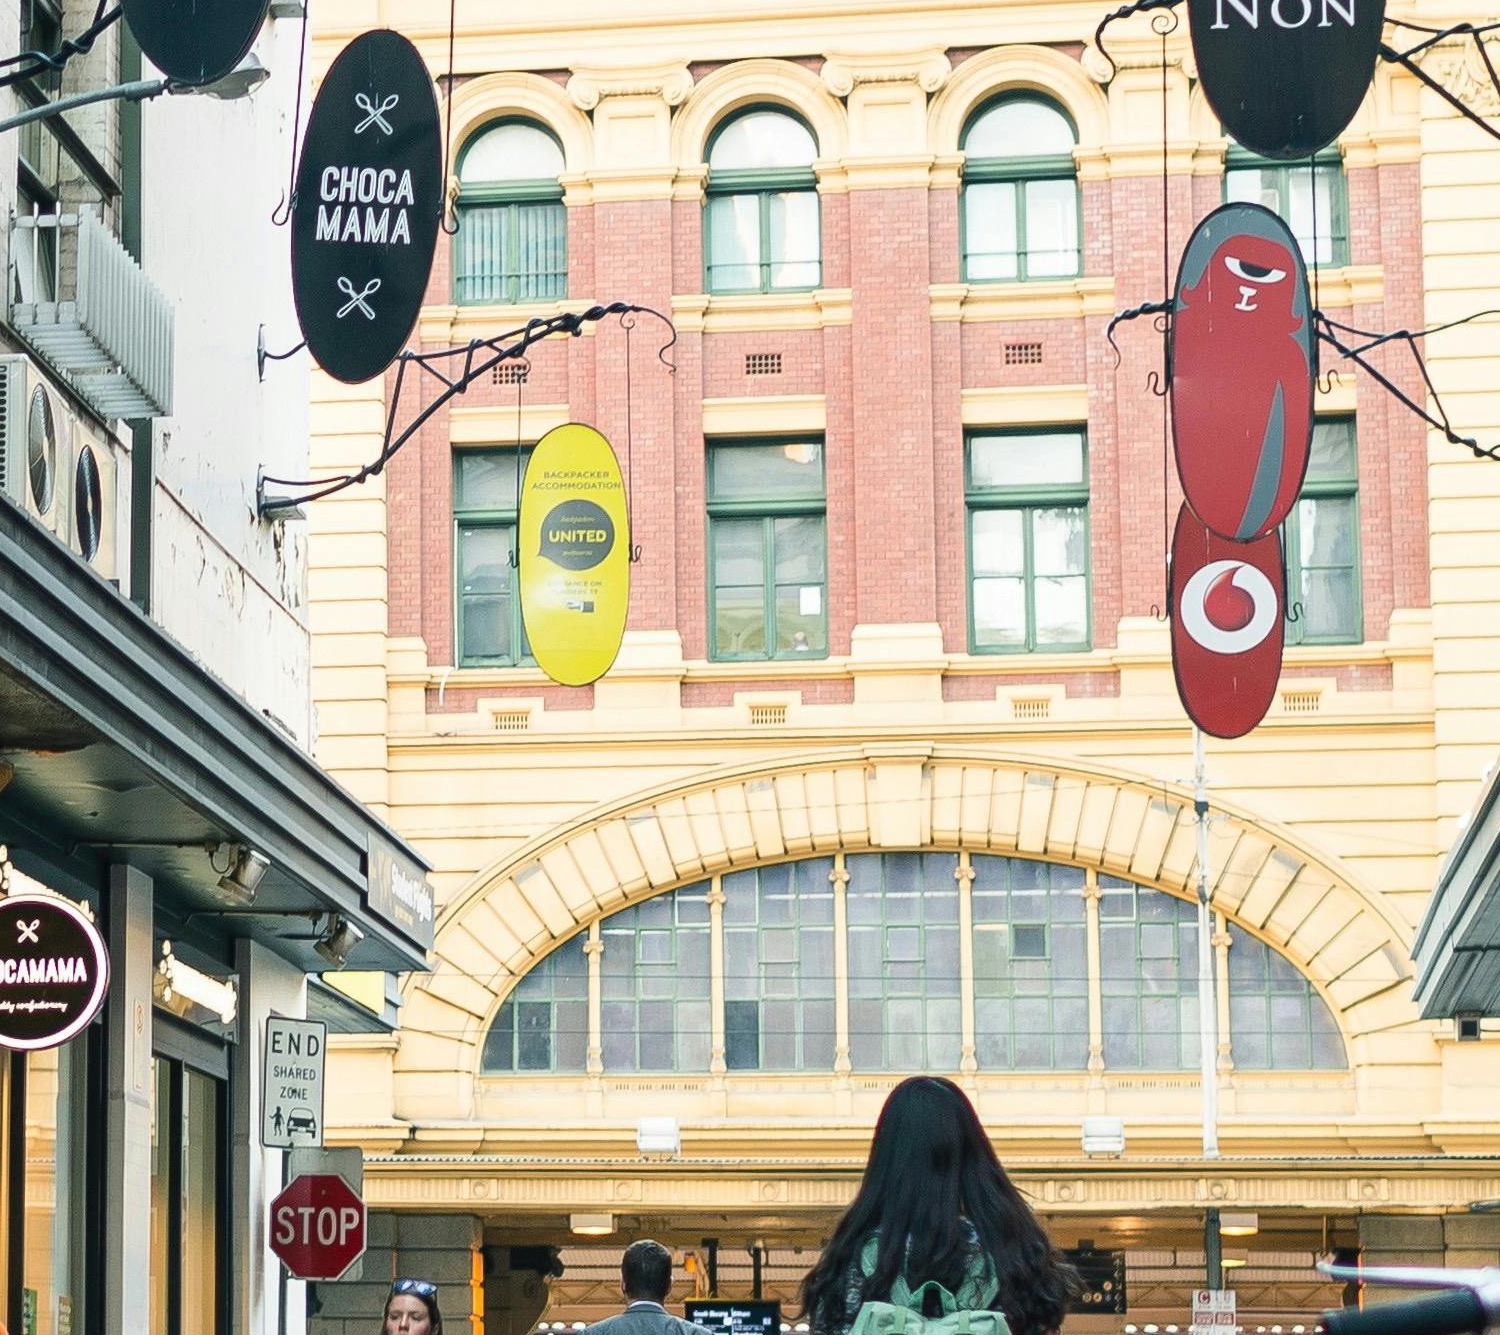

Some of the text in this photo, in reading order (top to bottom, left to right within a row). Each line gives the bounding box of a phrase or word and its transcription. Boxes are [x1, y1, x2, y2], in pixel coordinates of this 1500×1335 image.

[319, 165, 415, 208] CHOCA
[314, 203, 413, 246] MAMA
[543, 470, 610, 480] BACKPACKER
[531, 481, 622, 491] ACCOMMODATION
[548, 528, 608, 544] UNITED
[271, 1030, 321, 1057] END
[273, 1064, 317, 1082] SHARED
[279, 1086, 309, 1101] ZONE
[275, 1205, 361, 1246] STOP
